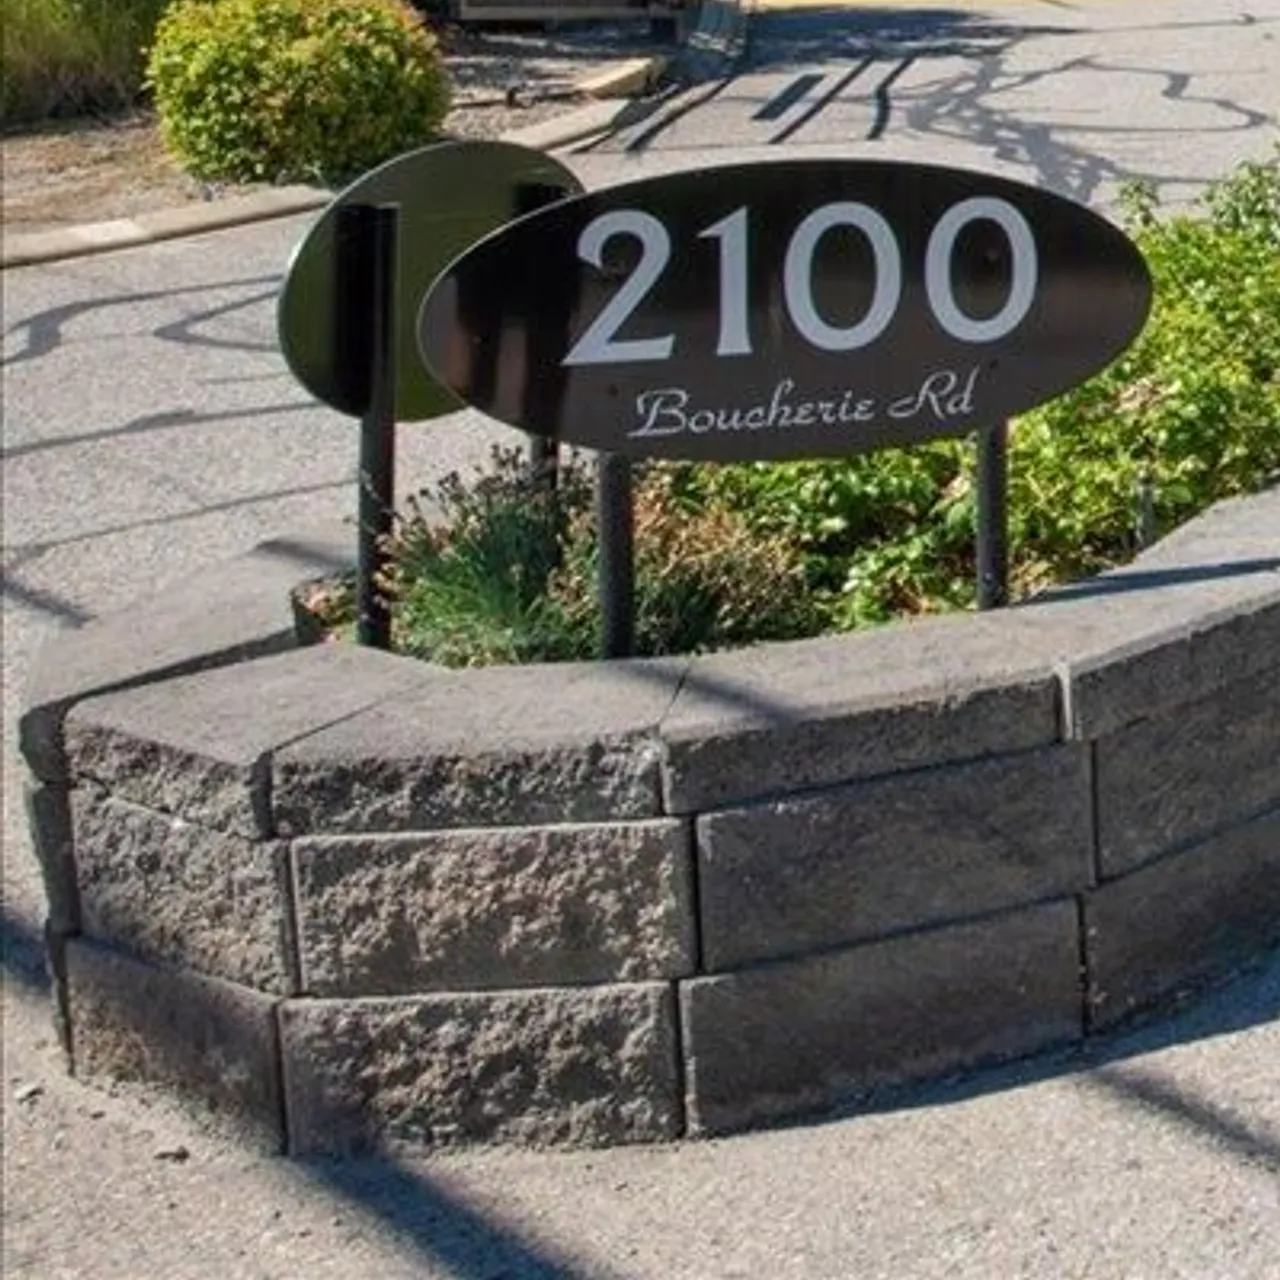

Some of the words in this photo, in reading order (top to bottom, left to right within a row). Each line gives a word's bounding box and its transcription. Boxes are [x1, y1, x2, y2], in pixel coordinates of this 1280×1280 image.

[561, 197, 1039, 367] 2100
[627, 379, 875, 439] Boucherie
[889, 364, 977, 422] Rd
